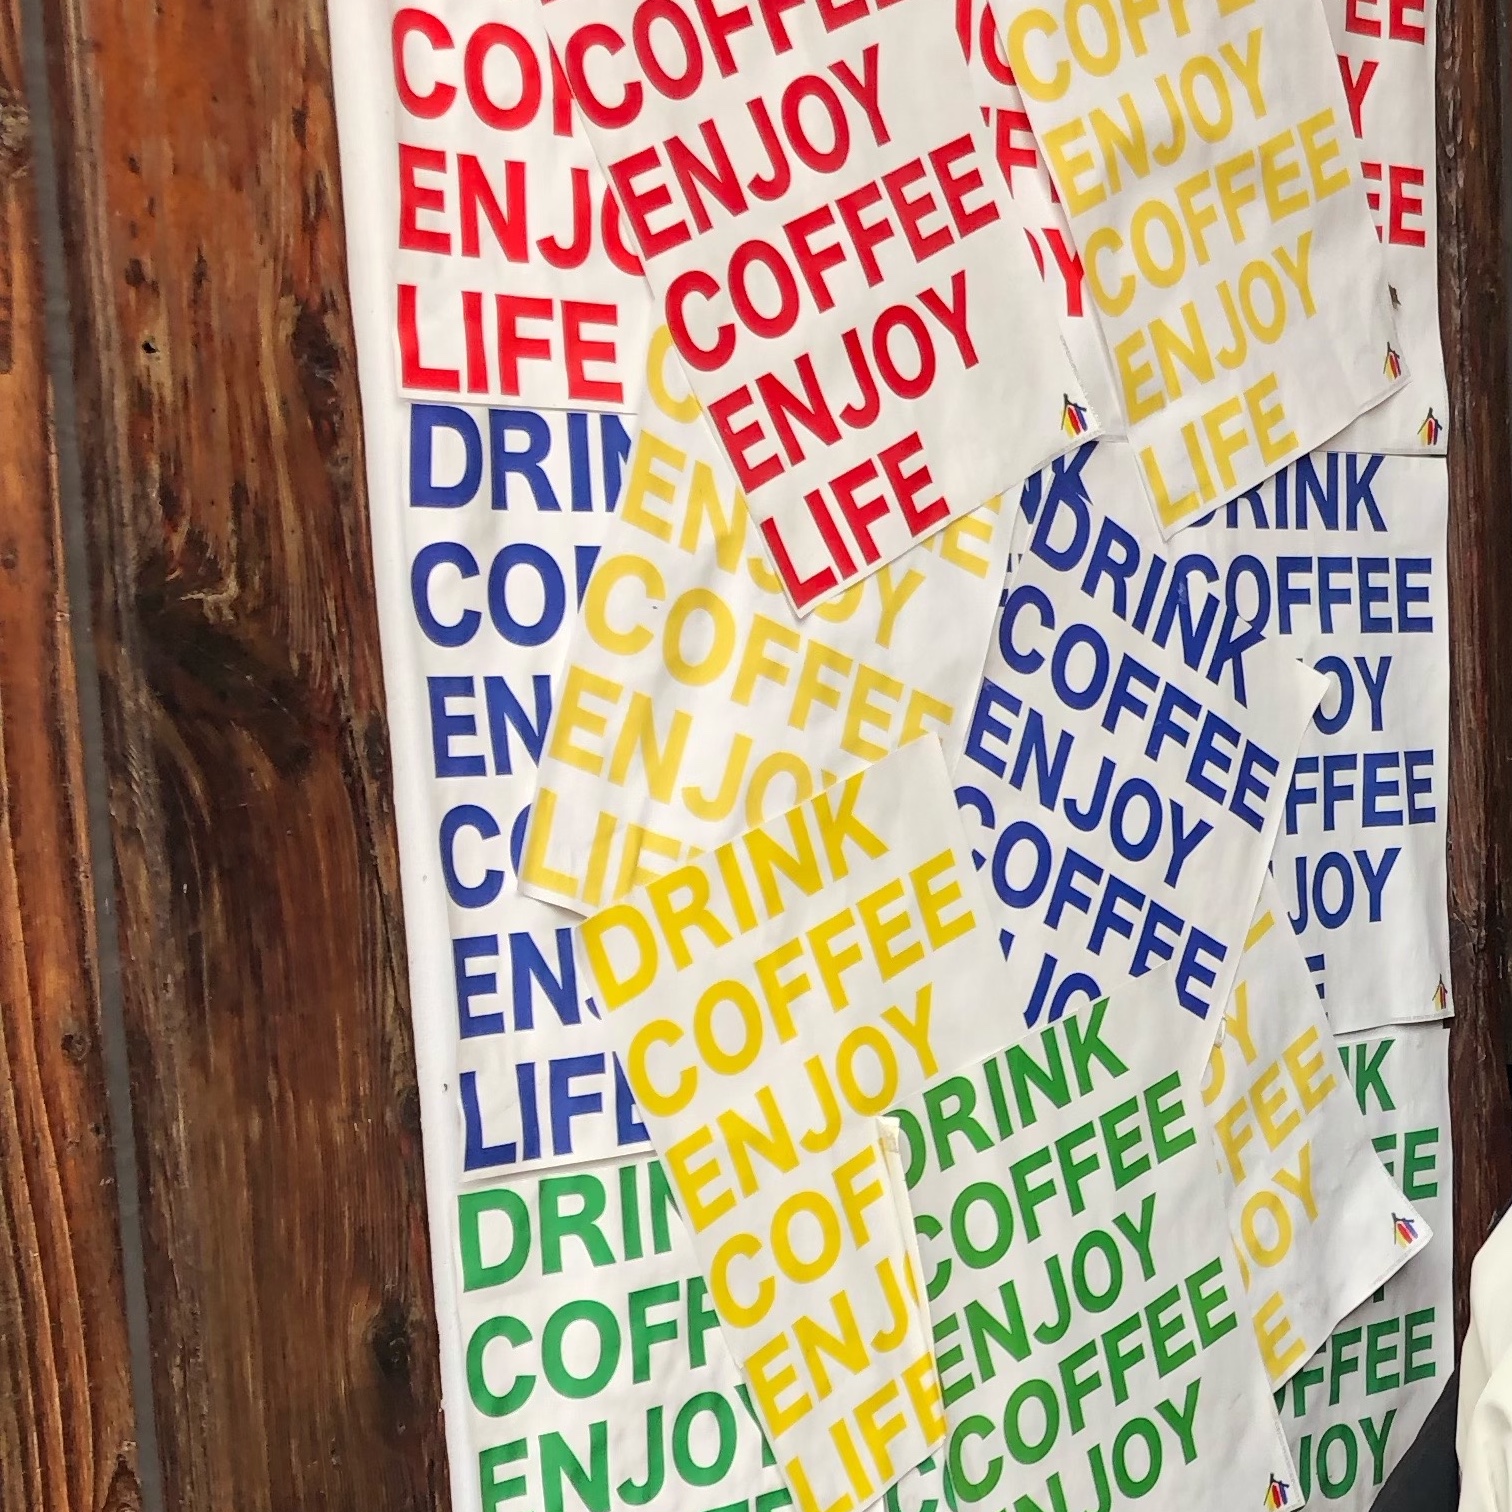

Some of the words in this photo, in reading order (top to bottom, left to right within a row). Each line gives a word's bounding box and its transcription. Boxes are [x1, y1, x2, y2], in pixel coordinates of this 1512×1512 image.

[607, 43, 892, 260] ENJOY
[1041, 27, 1268, 218] ENJOY
[1084, 108, 1352, 318] COFFEE
[396, 283, 625, 404] LIFE
[664, 133, 1001, 372] COFFEE
[1113, 230, 1318, 426] ENJOY
[707, 270, 979, 495] ENJOY
[1139, 372, 1299, 530] LIFE
[760, 431, 951, 609] LIFE
[1029, 488, 1268, 710] DRINK
[964, 676, 1214, 890] ENJOY
[998, 584, 1280, 834] COFFEE
[579, 770, 890, 1013] DRINK
[627, 848, 978, 1119] COFFEE
[664, 982, 941, 1235] ENJOY
[913, 1070, 1198, 1303] COFFEE
[708, 1136, 894, 1330] COF
[932, 1192, 1158, 1410] ENJOY
[743, 1248, 920, 1440] ENJ
[948, 1257, 1239, 1503] COFFEE
